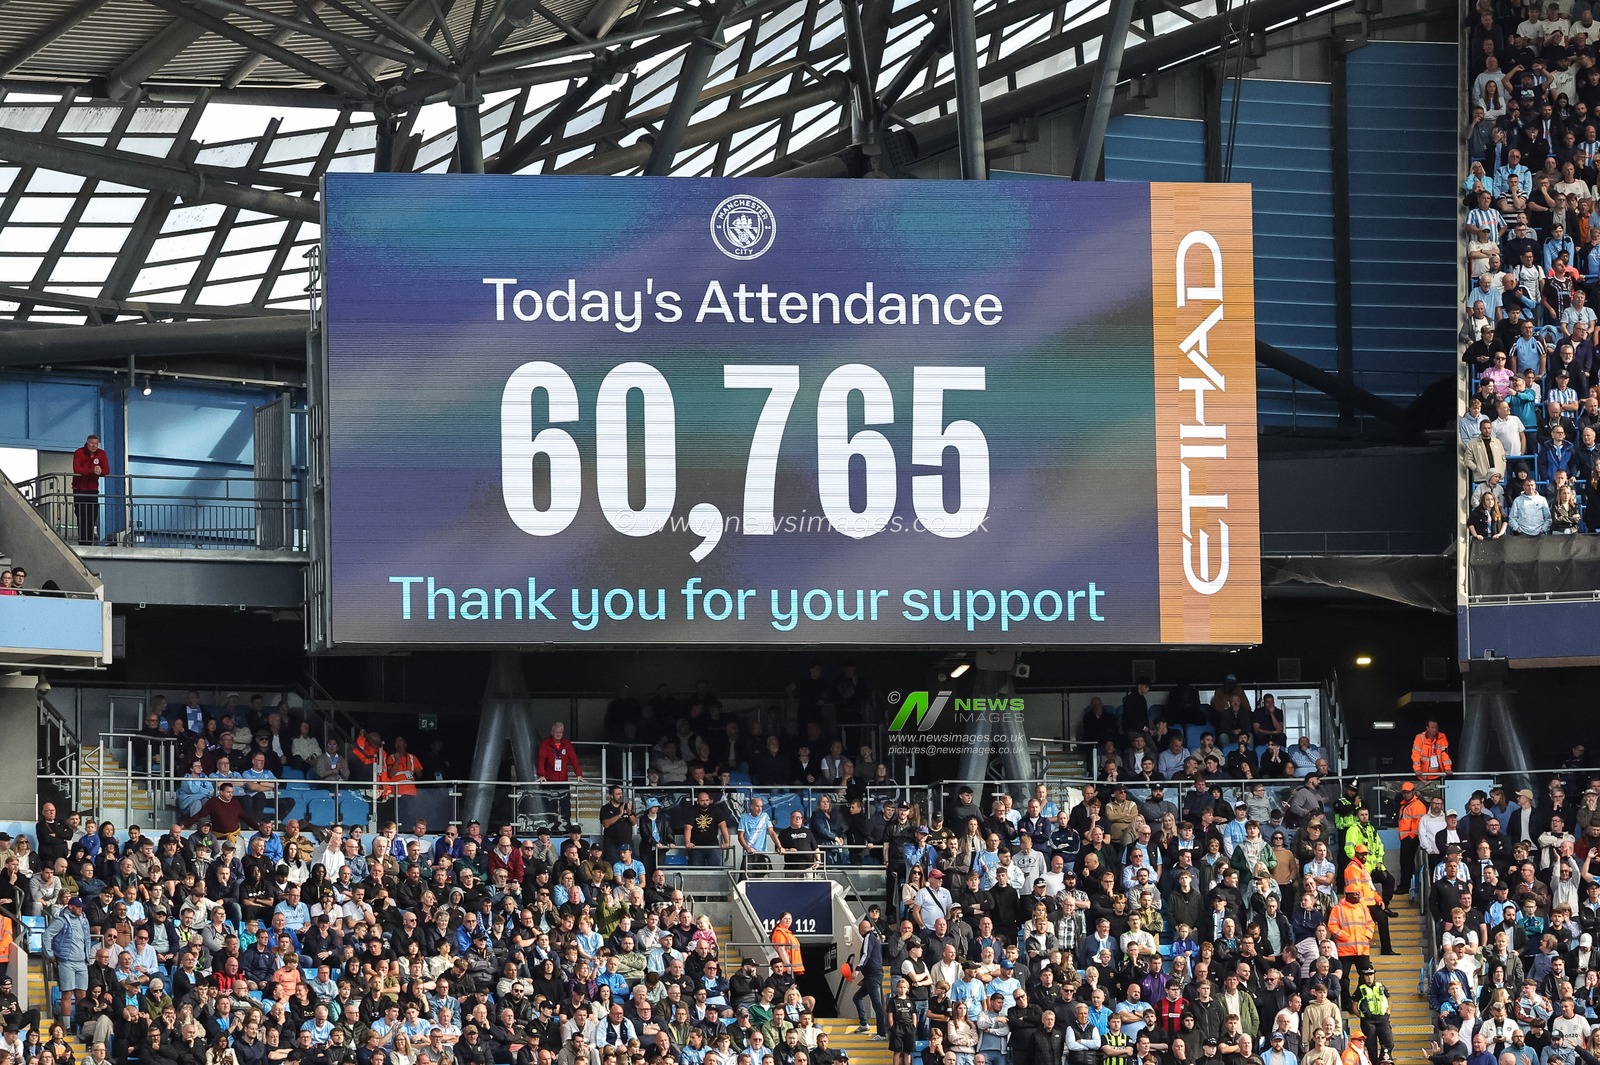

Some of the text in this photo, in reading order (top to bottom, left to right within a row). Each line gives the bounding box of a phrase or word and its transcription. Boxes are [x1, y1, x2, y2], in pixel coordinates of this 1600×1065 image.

[718, 199, 769, 221] MANCHESTER
[482, 278, 1003, 333] Today's Attendance
[1175, 230, 1230, 595] ETIHAD
[500, 361, 991, 563] 60,765
[388, 576, 1105, 632] Thank you for your support
[795, 918, 816, 933] 112
